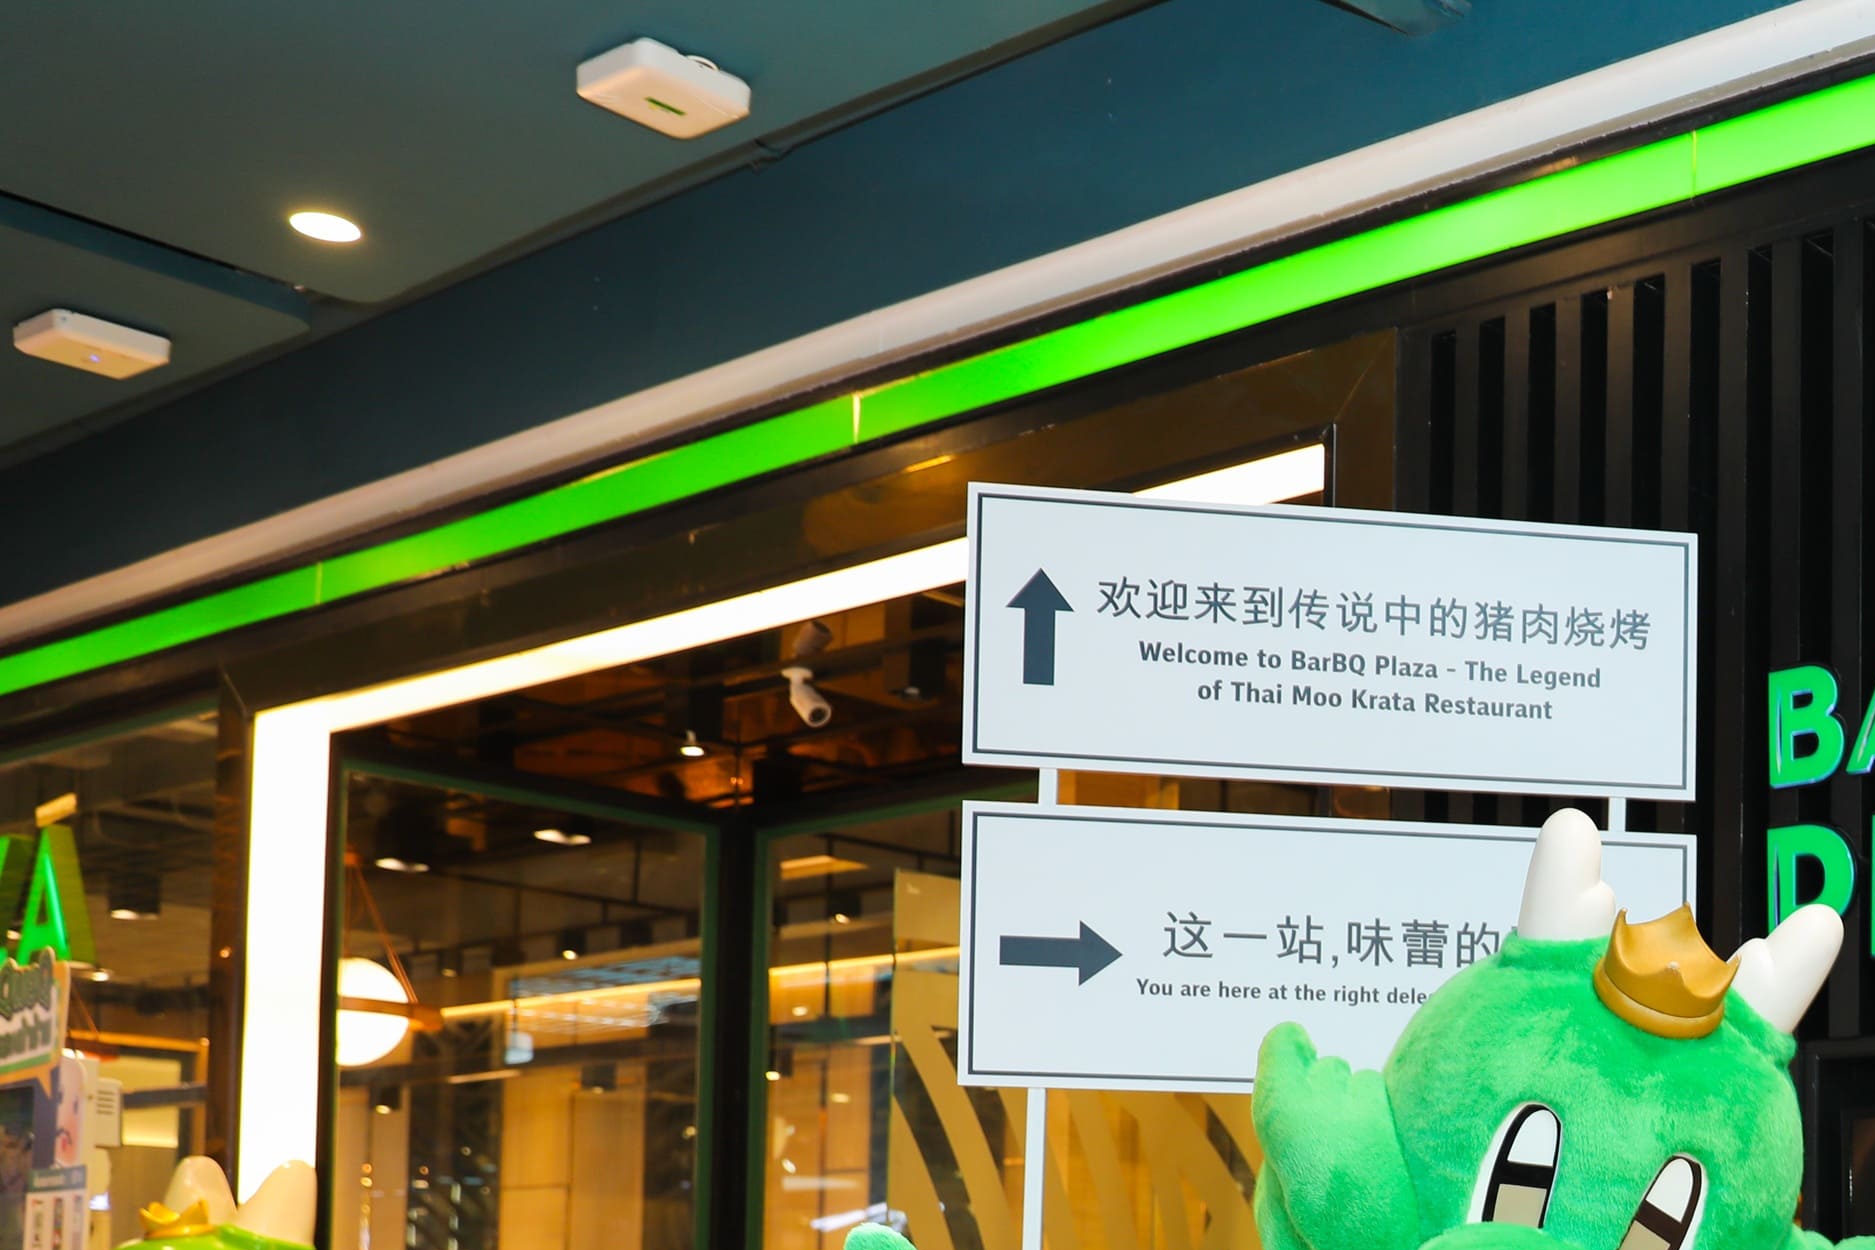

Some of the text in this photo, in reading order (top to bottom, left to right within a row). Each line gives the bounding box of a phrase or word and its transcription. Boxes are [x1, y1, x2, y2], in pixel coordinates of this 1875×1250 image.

[1097, 576, 1651, 651] 欢迎来到传说中的猪肉烧烤
[1138, 640, 1249, 668] Welcome
[1256, 648, 1282, 669] to
[1291, 650, 1366, 677] BarBQ
[1375, 655, 1438, 679] Plaza
[1464, 660, 1508, 683] The
[1516, 664, 1601, 690] Legend
[1197, 679, 1555, 720] of Thai Moo Krata Restaurant
[1163, 911, 1518, 968] 这一站,味蕾的
[1136, 978, 1173, 997] You
[1180, 984, 1211, 998] are
[1218, 980, 1262, 1000] here
[1268, 984, 1288, 1001] at
[1294, 983, 1327, 1002] the
[1333, 984, 1380, 1007] right
